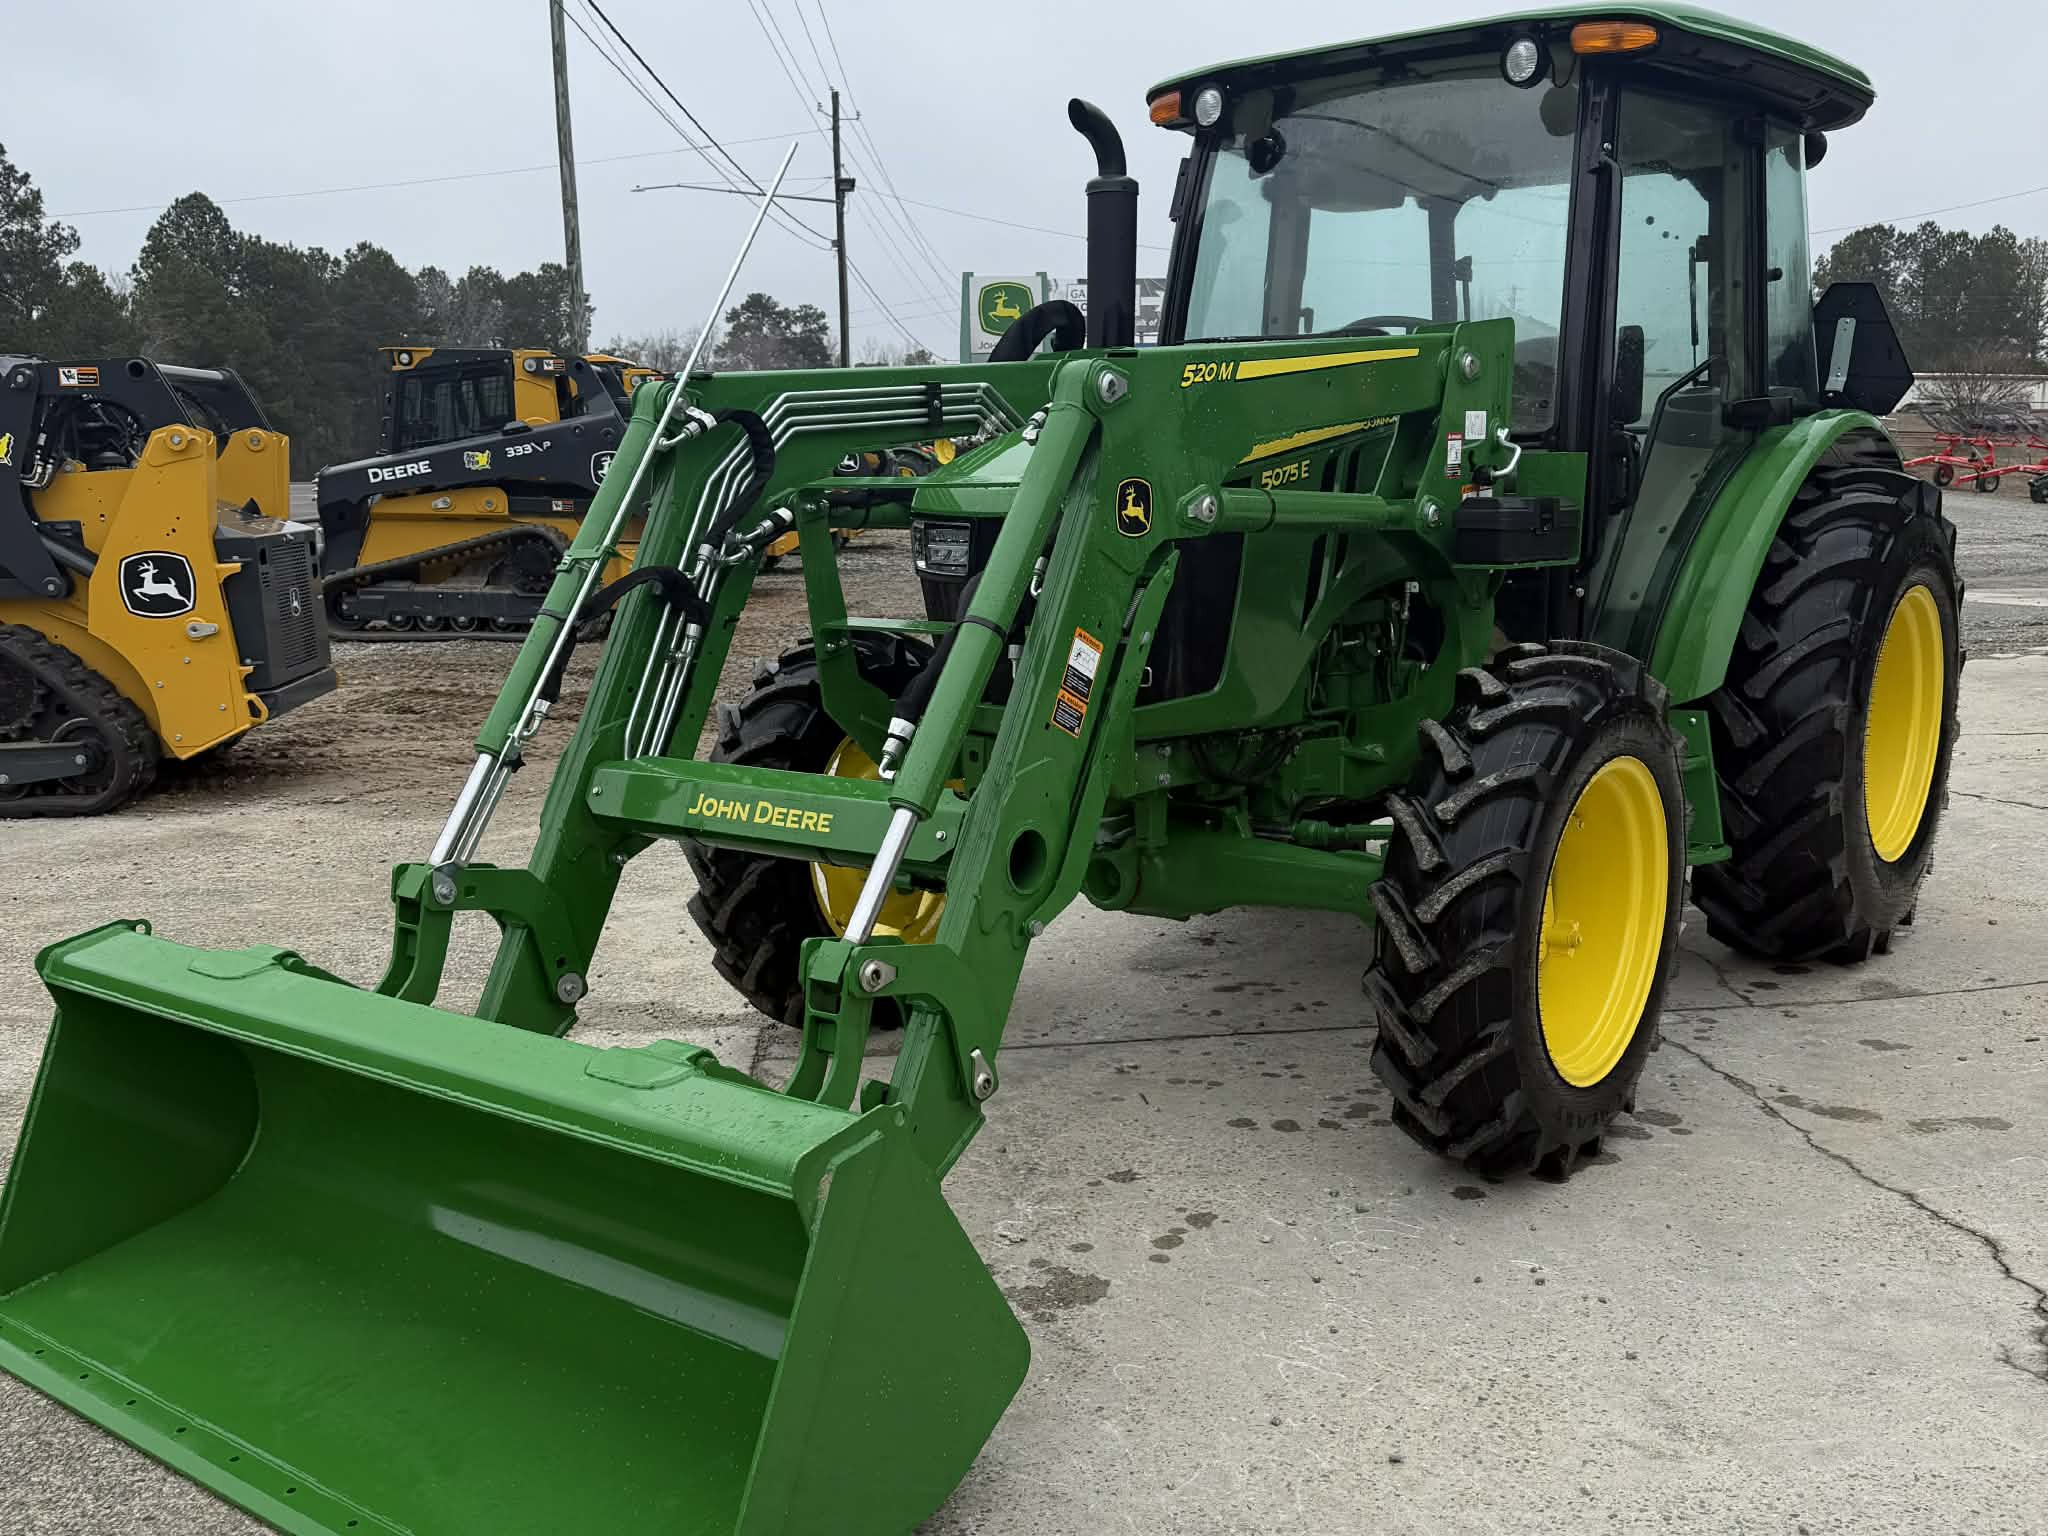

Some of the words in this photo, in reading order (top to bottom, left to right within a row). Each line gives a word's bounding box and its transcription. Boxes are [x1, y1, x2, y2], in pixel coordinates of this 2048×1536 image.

[1180, 362, 1218, 388] 520
[1218, 361, 1234, 381] M
[367, 460, 432, 484] DEERE
[1261, 463, 1299, 490] 5075
[1301, 459, 1311, 479] E
[688, 793, 751, 822] JOHN
[753, 800, 834, 833] DEERE
